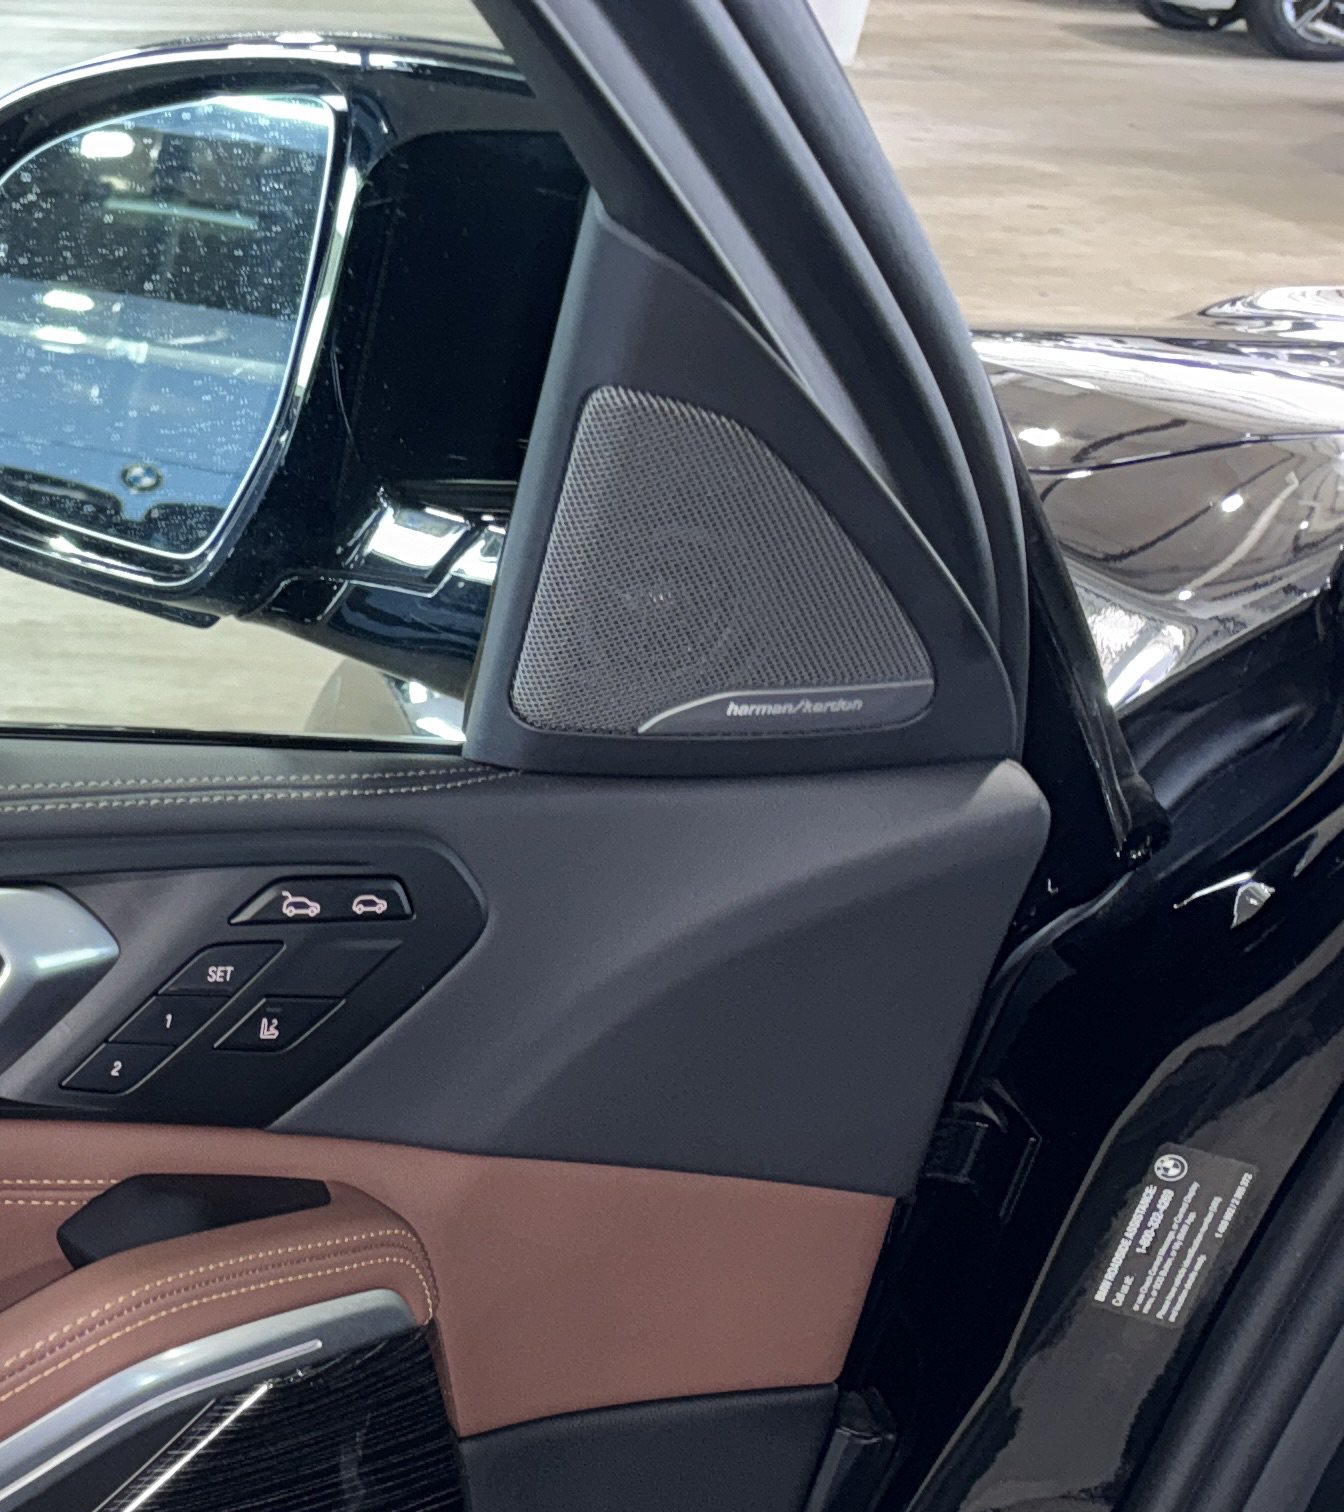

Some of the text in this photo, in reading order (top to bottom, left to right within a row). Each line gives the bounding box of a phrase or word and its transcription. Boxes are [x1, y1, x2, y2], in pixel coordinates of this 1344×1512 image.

[726, 698, 863, 717] harman/kardon
[207, 966, 235, 983] SET
[165, 1013, 173, 1029] 1
[110, 1060, 122, 1076] 2
